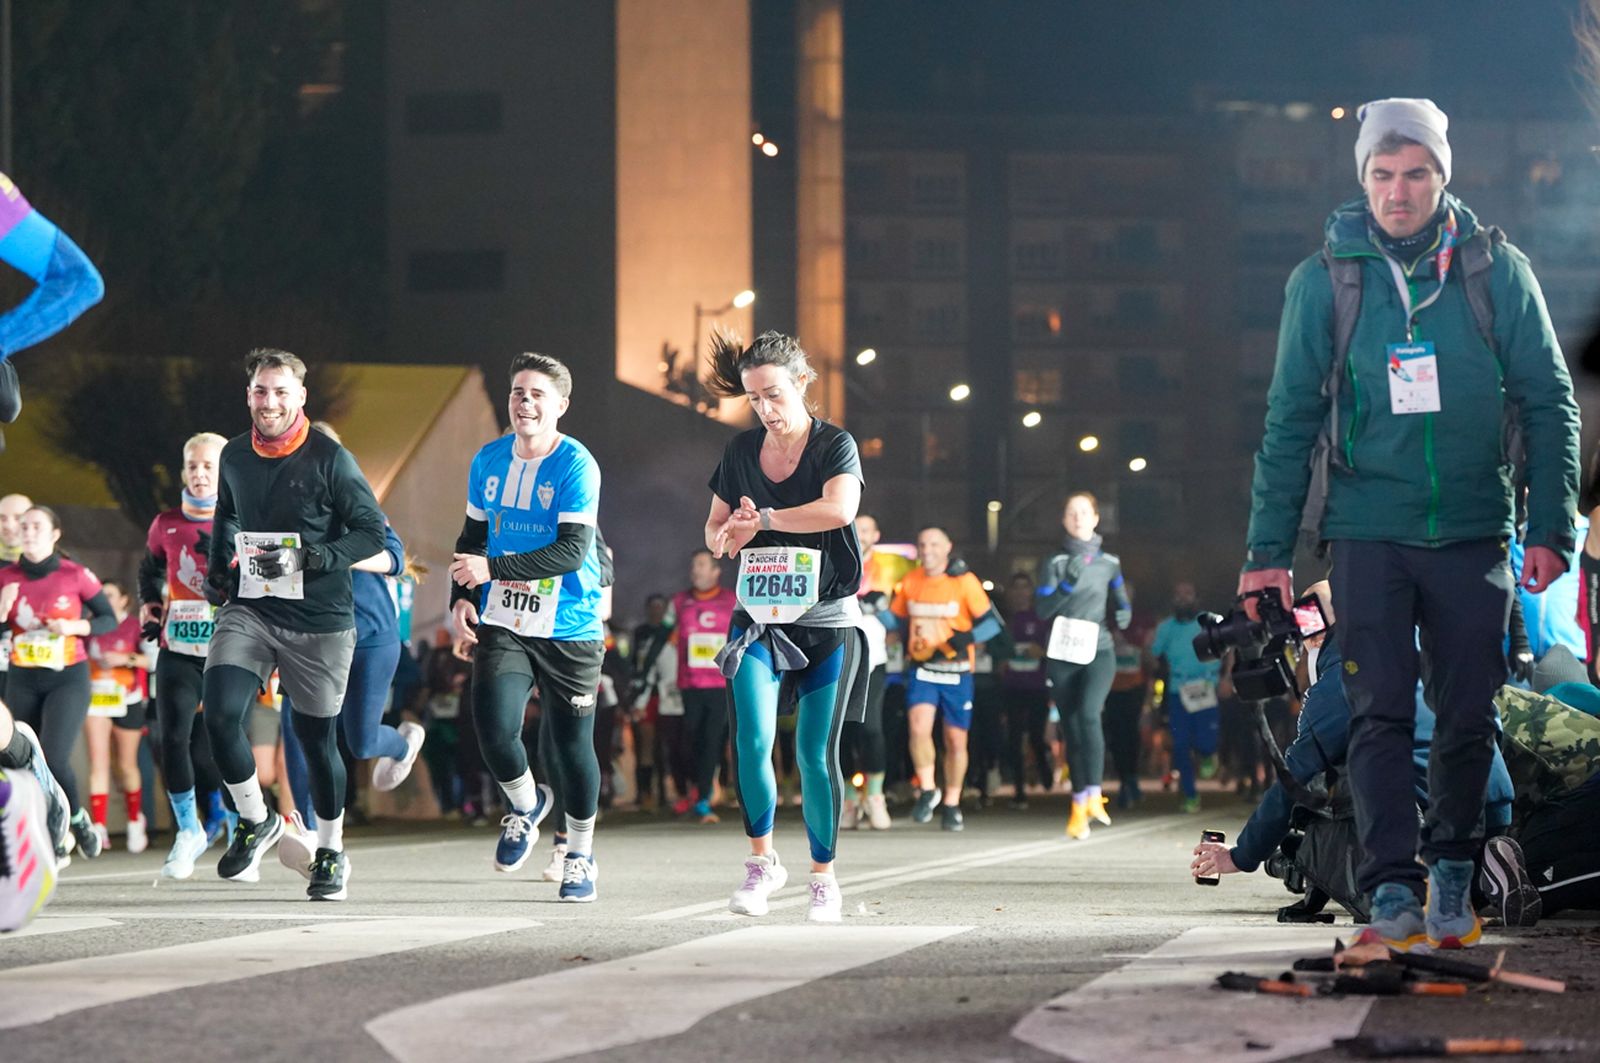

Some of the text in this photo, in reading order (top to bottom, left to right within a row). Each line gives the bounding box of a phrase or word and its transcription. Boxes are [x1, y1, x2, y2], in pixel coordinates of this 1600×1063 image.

[484, 475, 500, 502] 8
[747, 564, 761, 573] SAN
[755, 555, 788, 563] NOCHE DE
[746, 574, 807, 597] 12643
[502, 588, 541, 613] 3176
[699, 611, 716, 629] C
